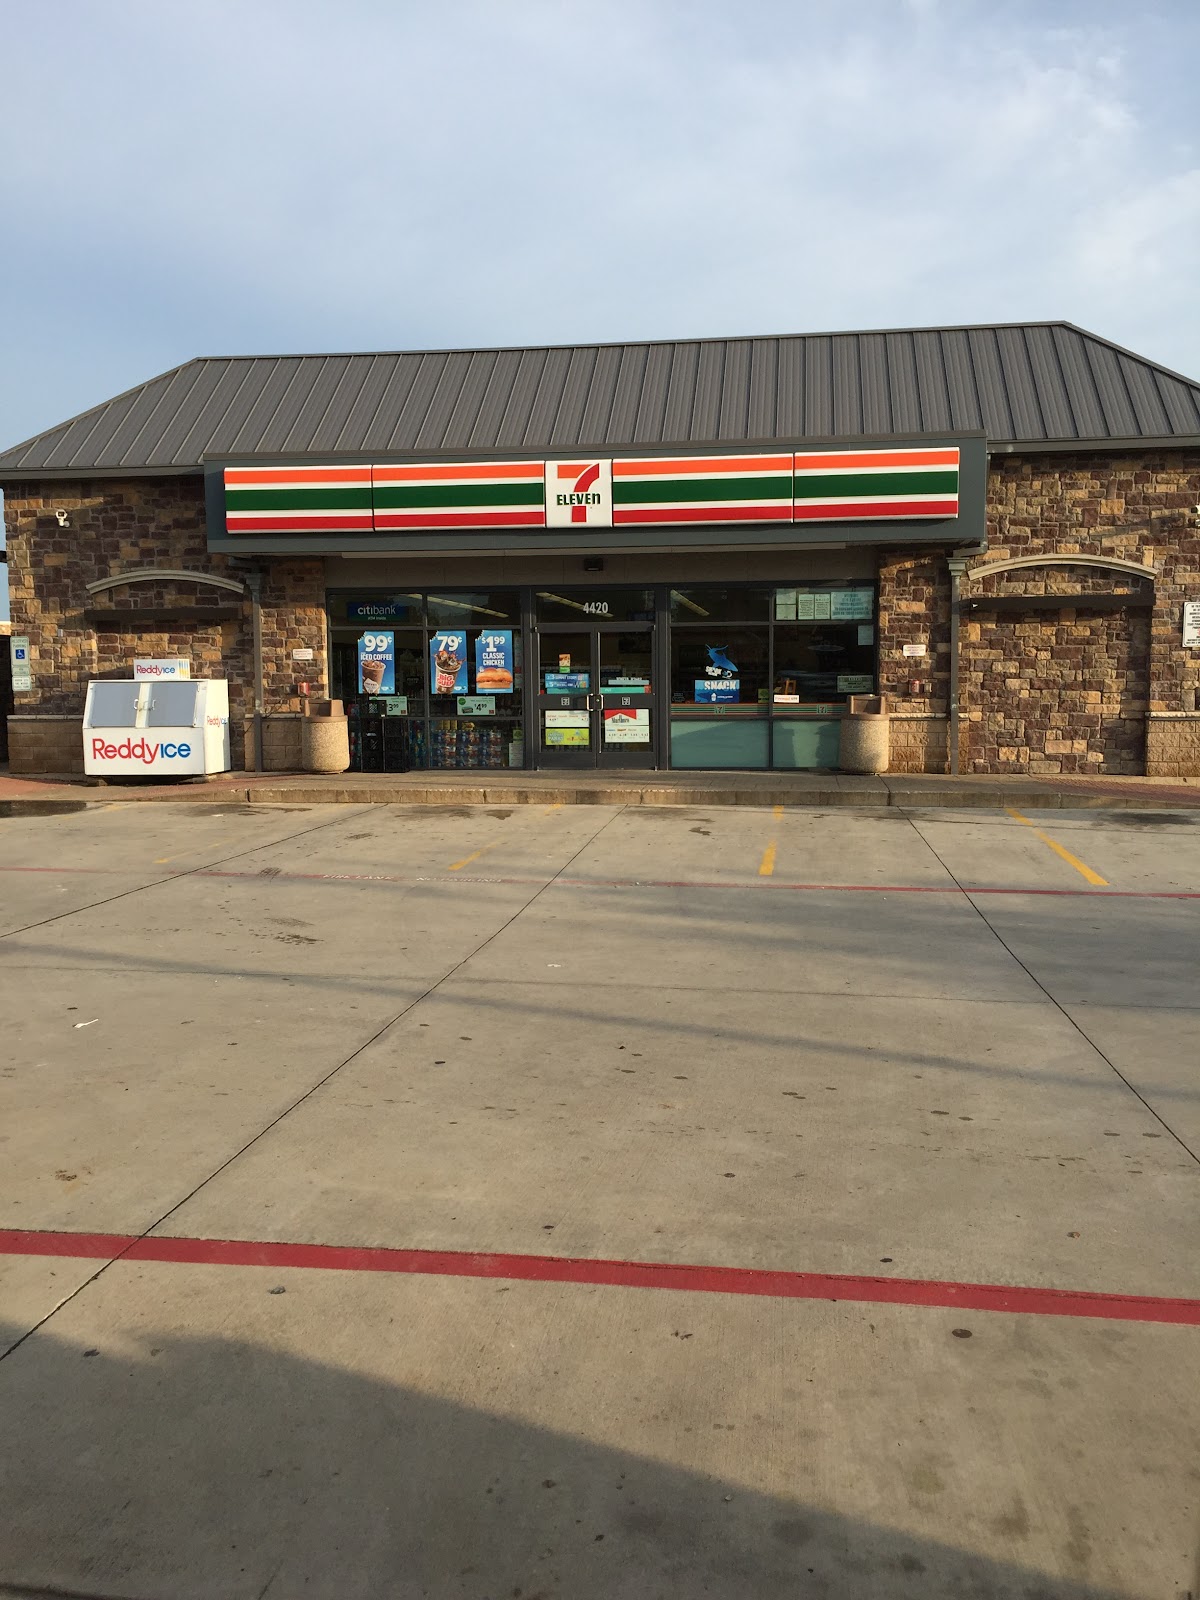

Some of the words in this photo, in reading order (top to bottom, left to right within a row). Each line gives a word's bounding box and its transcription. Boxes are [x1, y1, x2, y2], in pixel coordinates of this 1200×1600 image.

[557, 463, 600, 523] 7
[357, 605, 396, 615] citibank
[583, 602, 608, 614] 4420
[361, 652, 373, 660] ICED
[373, 653, 393, 661] COFFEE
